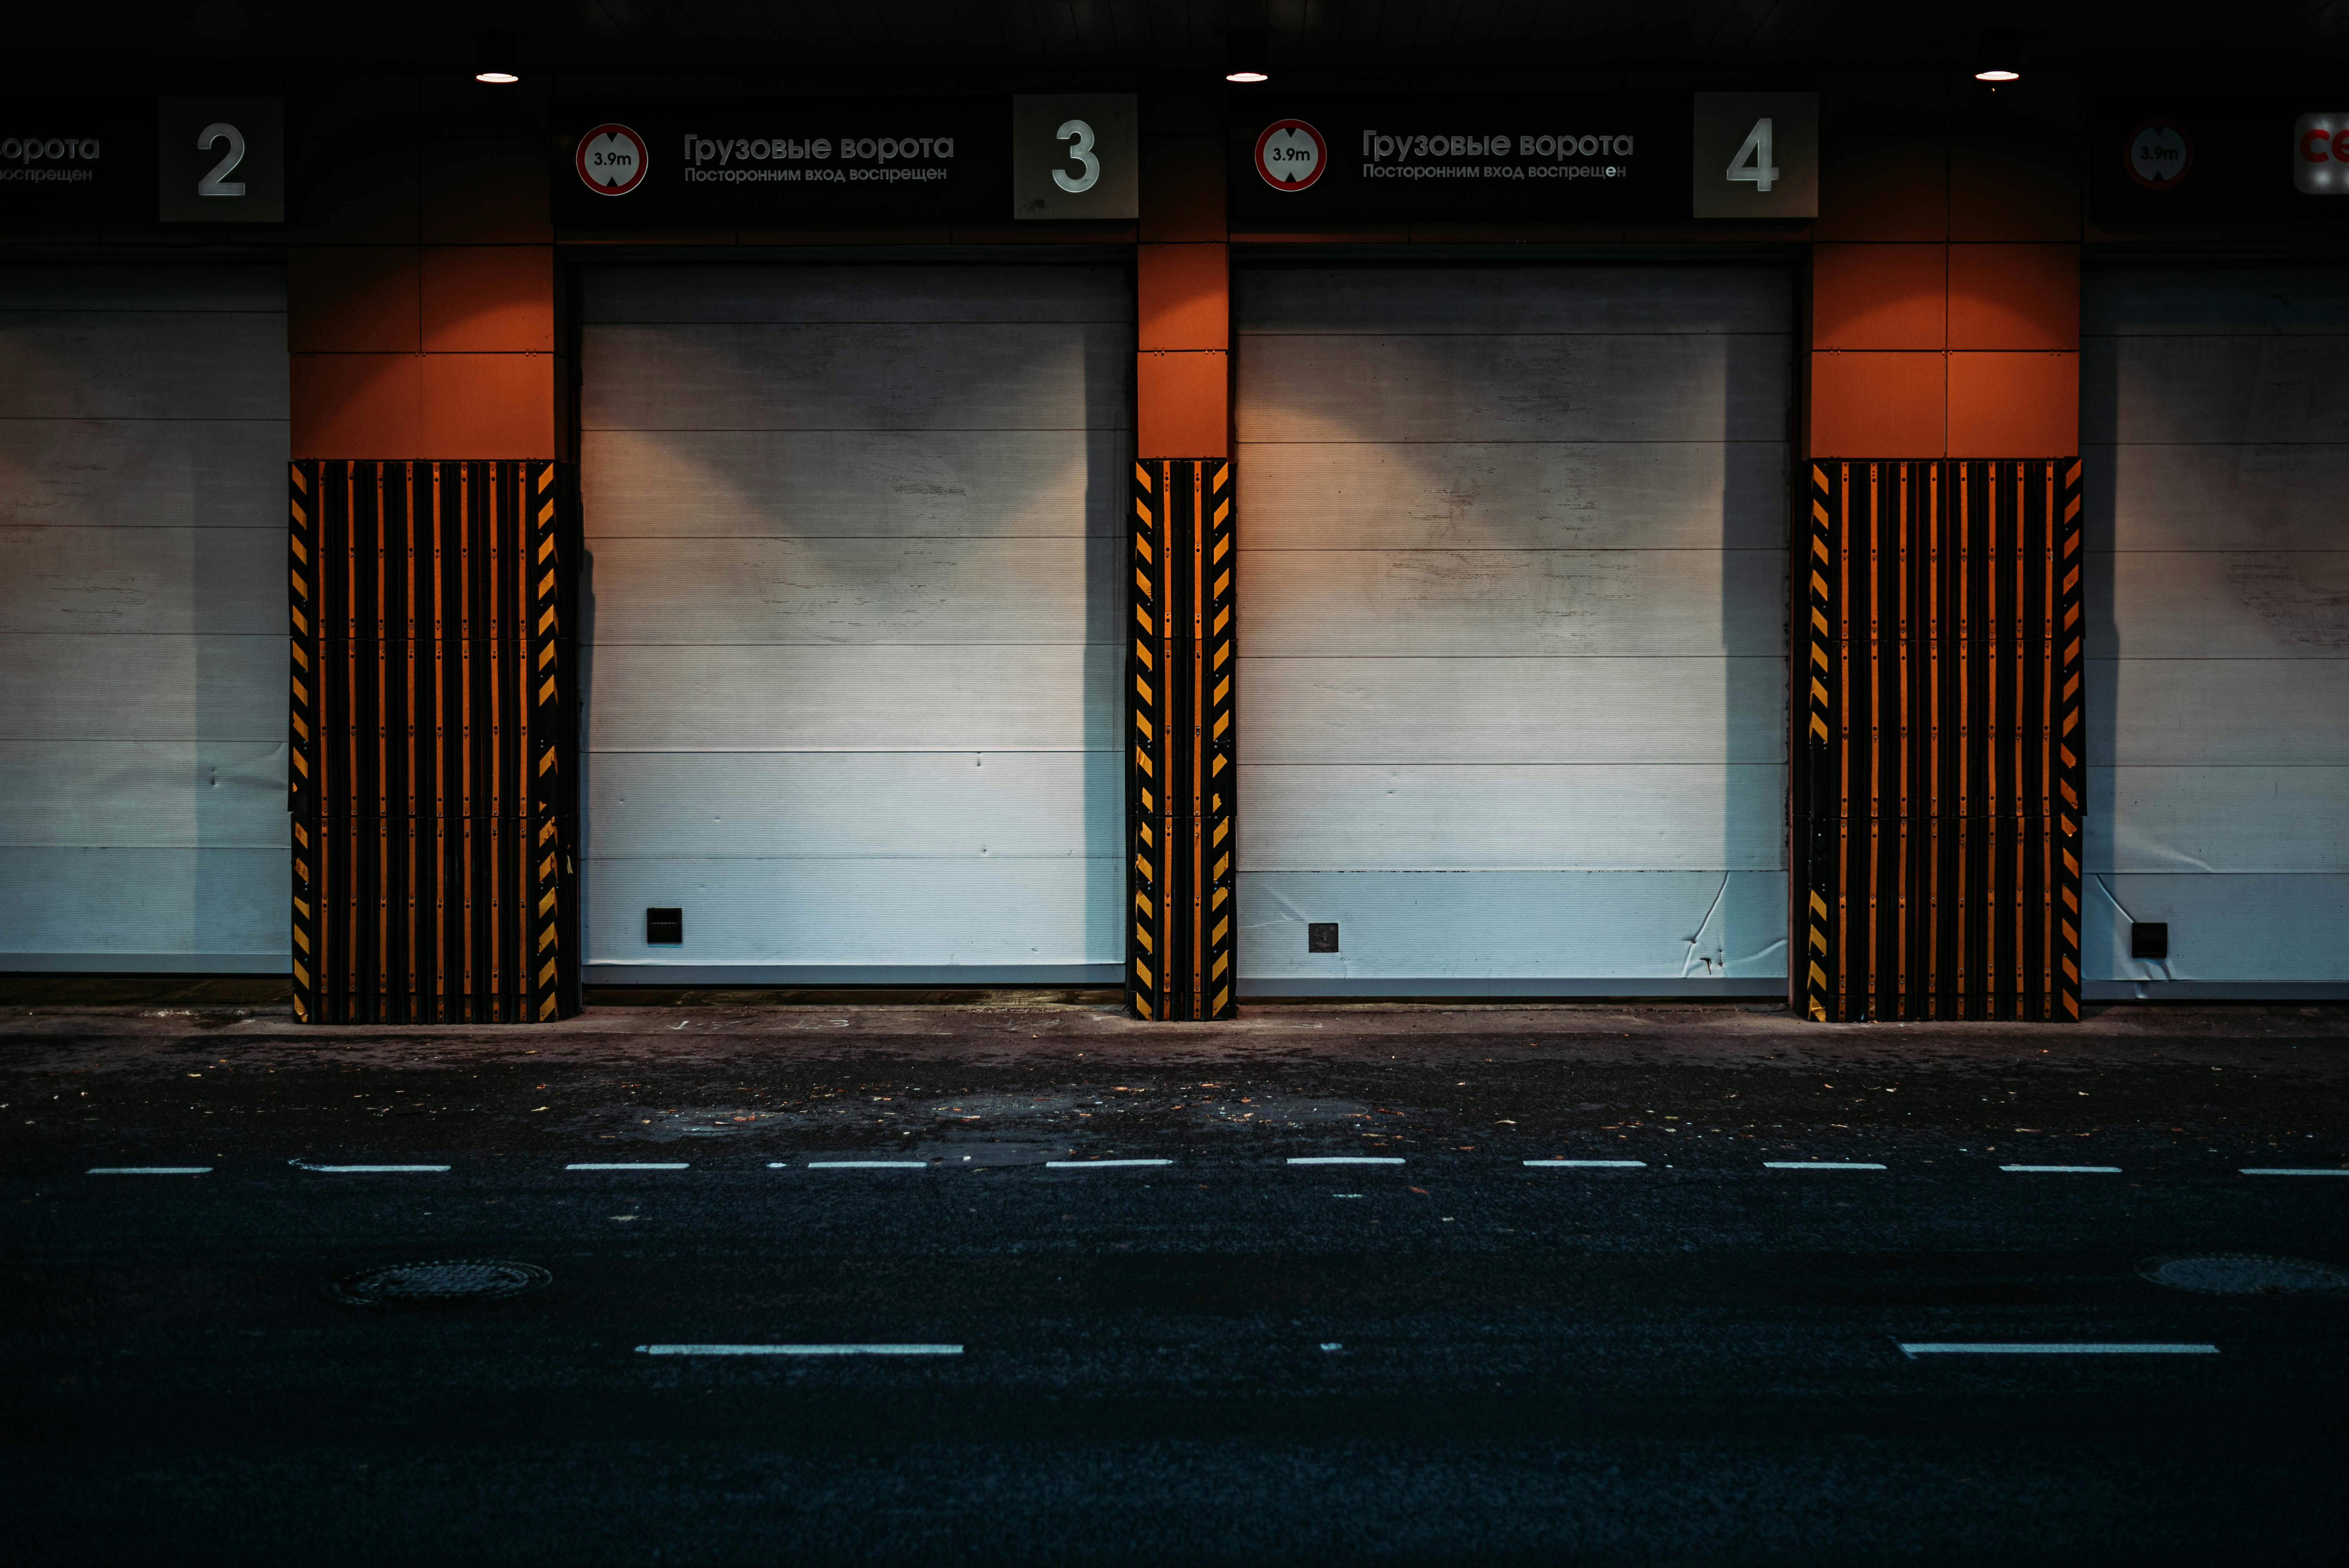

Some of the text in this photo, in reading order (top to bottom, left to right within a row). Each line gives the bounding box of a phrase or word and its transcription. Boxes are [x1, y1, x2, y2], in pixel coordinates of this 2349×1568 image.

[0, 137, 99, 164] орота
[197, 122, 246, 196] 2
[594, 152, 631, 166] 3.9m
[684, 134, 954, 166] Грузовые ворота
[1052, 119, 1100, 193] 3
[1273, 148, 1310, 161] 3.9m
[1363, 130, 1633, 162] Грузовые ворота
[1726, 118, 1779, 192] 4
[2140, 146, 2179, 160] 3.9m
[685, 168, 947, 184] Посторонним вход воспрещен
[1363, 164, 1626, 180] Посторонним вход воспрещен
